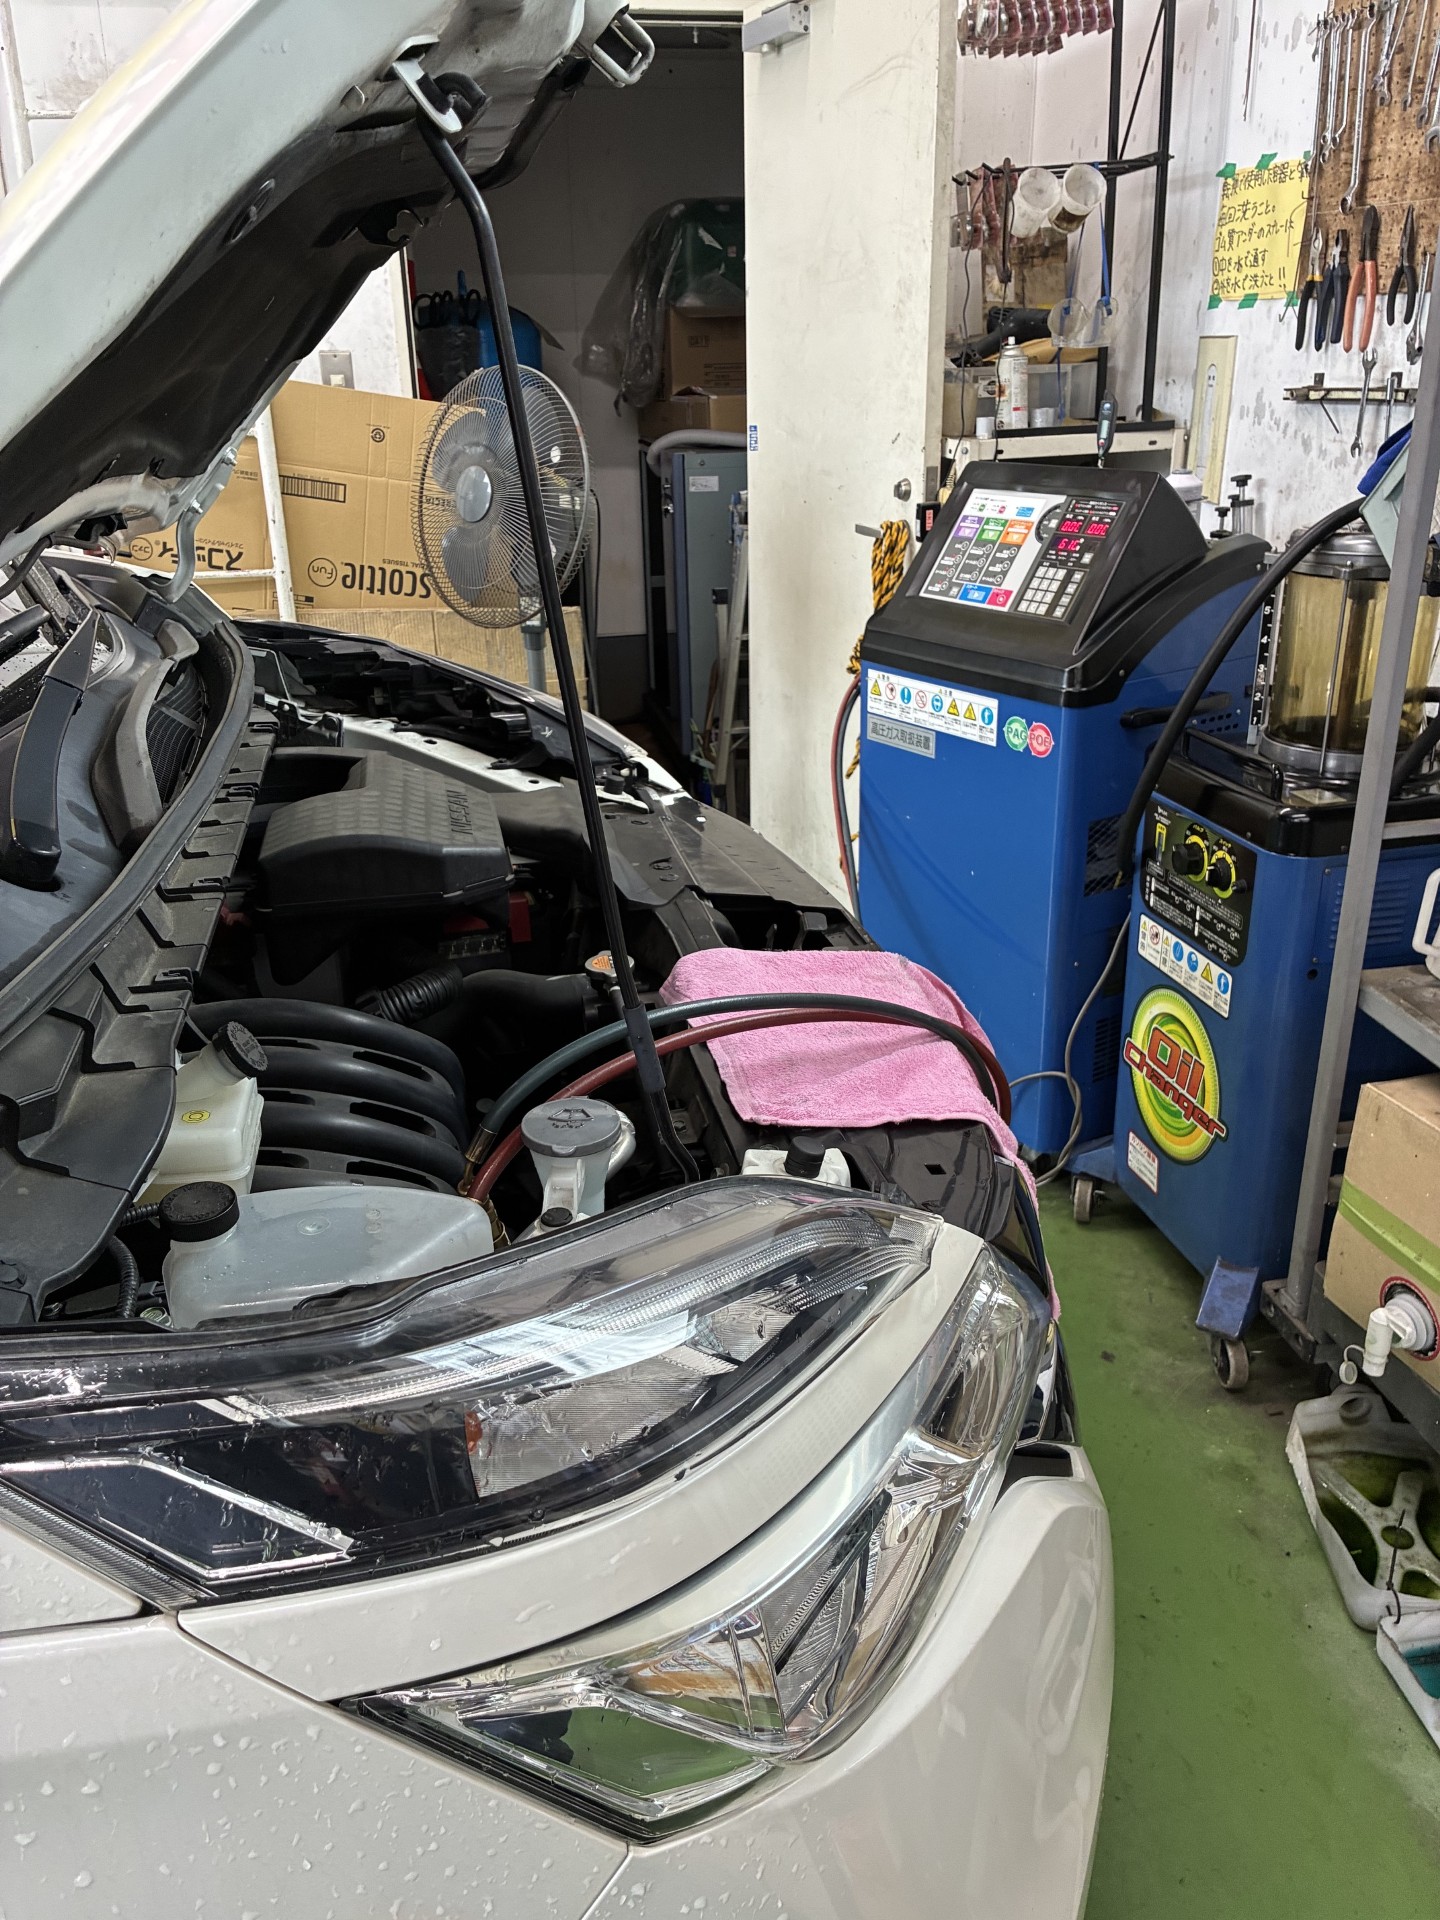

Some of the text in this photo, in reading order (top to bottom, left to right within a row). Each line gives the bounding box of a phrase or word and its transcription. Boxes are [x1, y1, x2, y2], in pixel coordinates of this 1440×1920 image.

[341, 562, 432, 598] scottie
[871, 721, 931, 750] 高圧ガス取扱装置
[1006, 726, 1027, 740] PAG
[1030, 731, 1050, 748] POE
[446, 789, 473, 835] NISSAN
[1147, 1026, 1205, 1100] Oil
[1124, 1037, 1226, 1138] Changer
